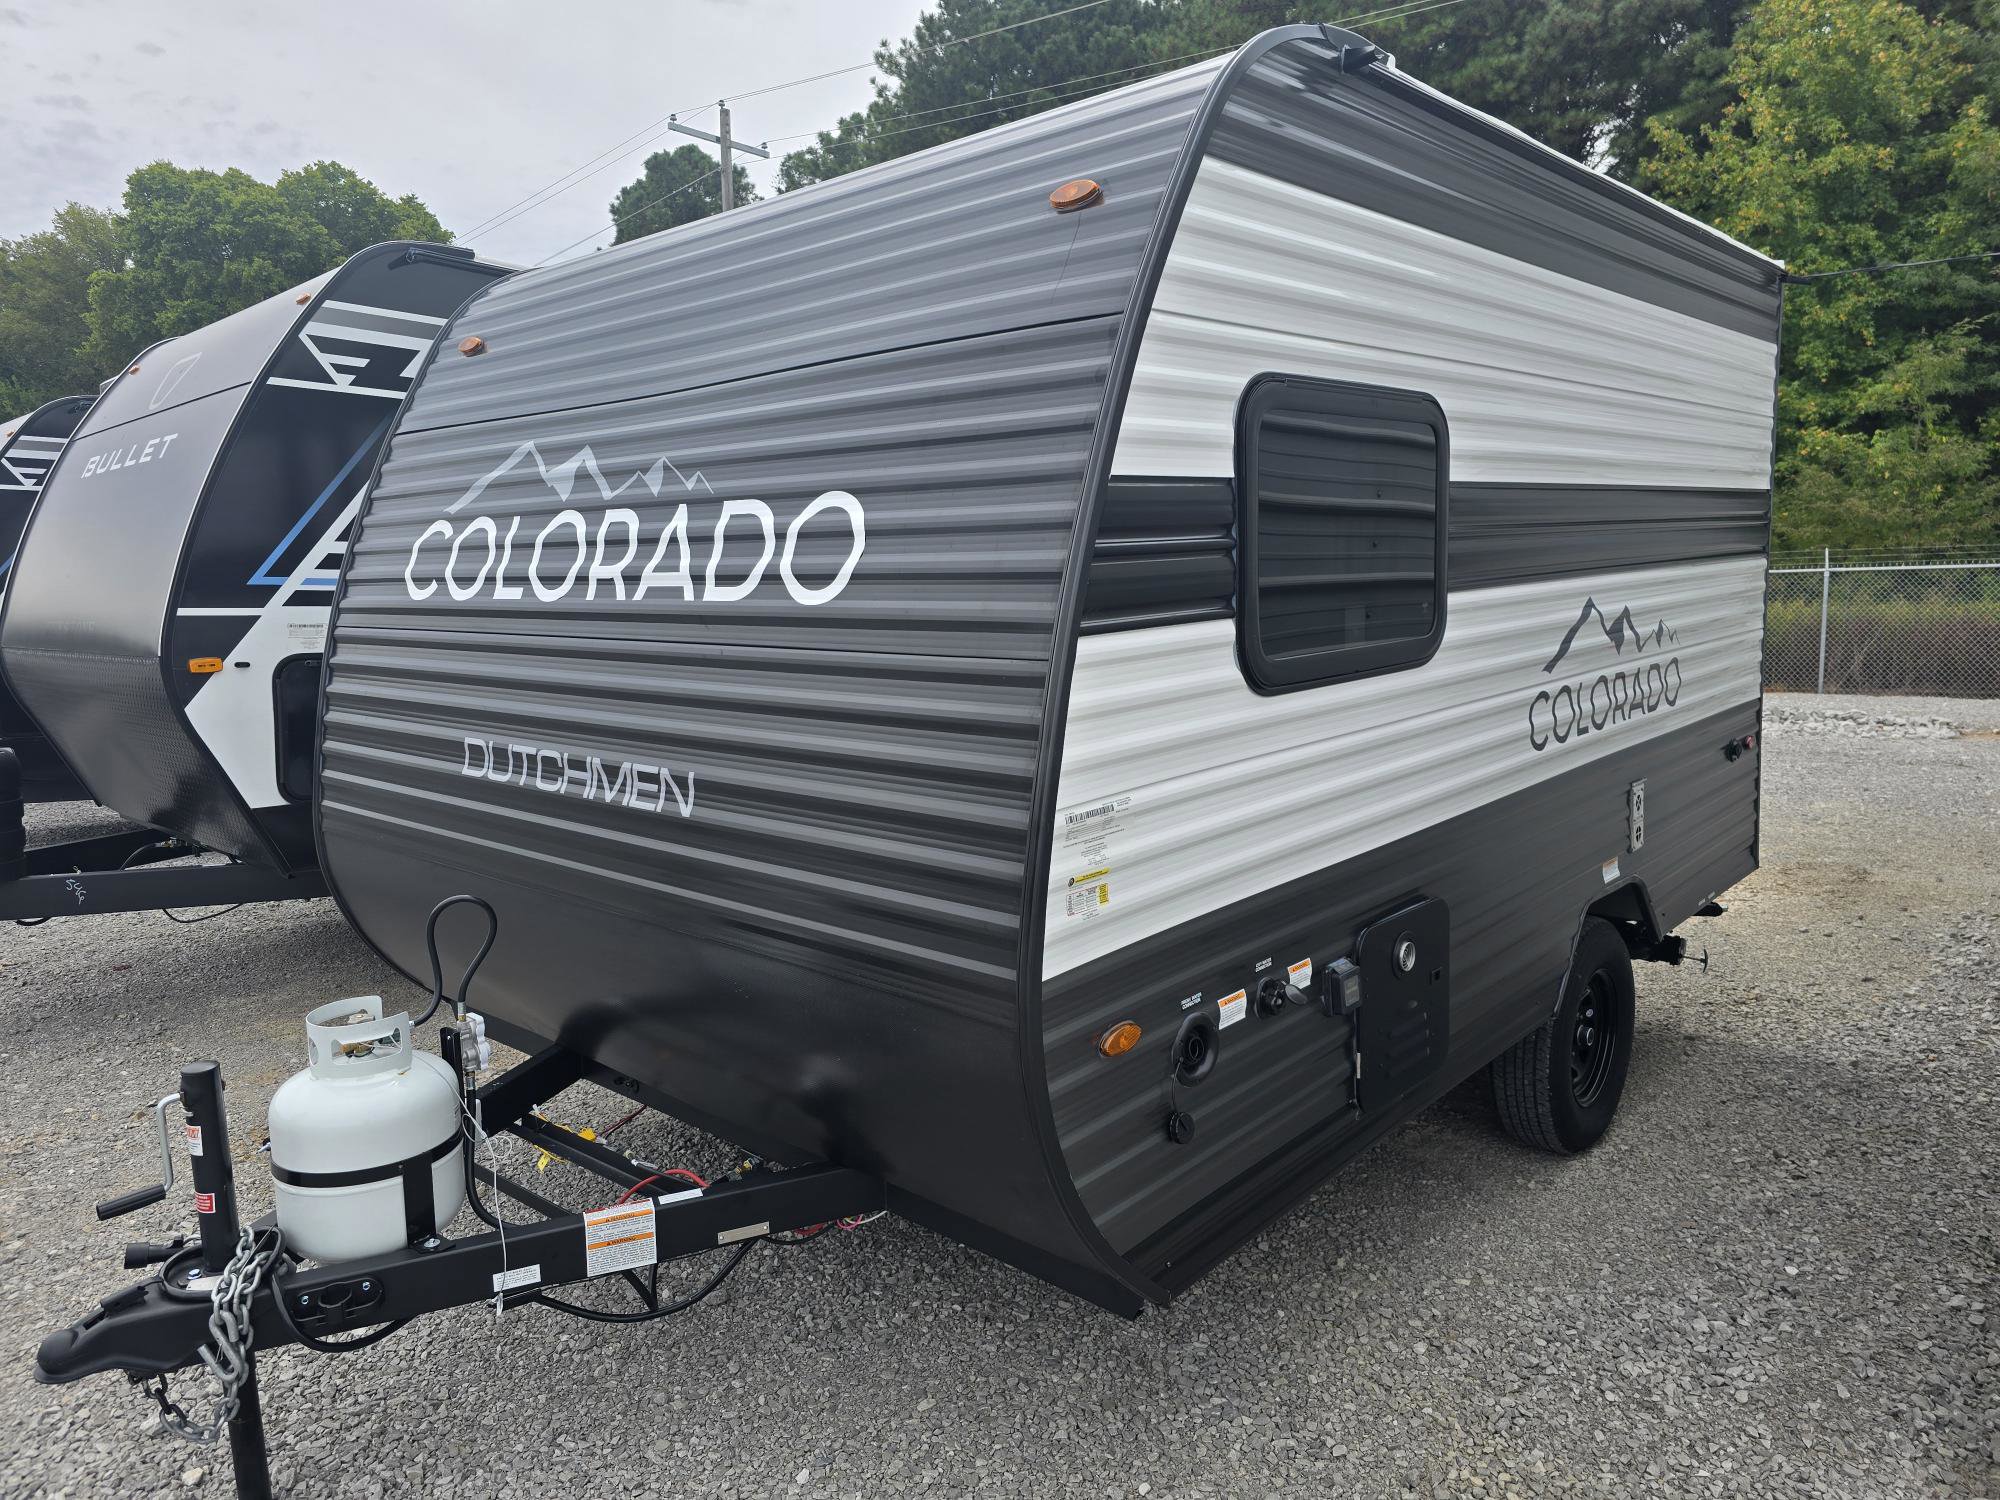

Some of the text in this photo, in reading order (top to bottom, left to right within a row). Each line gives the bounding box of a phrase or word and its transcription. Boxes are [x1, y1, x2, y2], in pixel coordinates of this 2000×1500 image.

[80, 432, 179, 479] BULLET
[404, 490, 867, 606] COLORADO
[1528, 656, 1682, 752] COLORADO
[461, 736, 695, 818] DUTCHMEN
